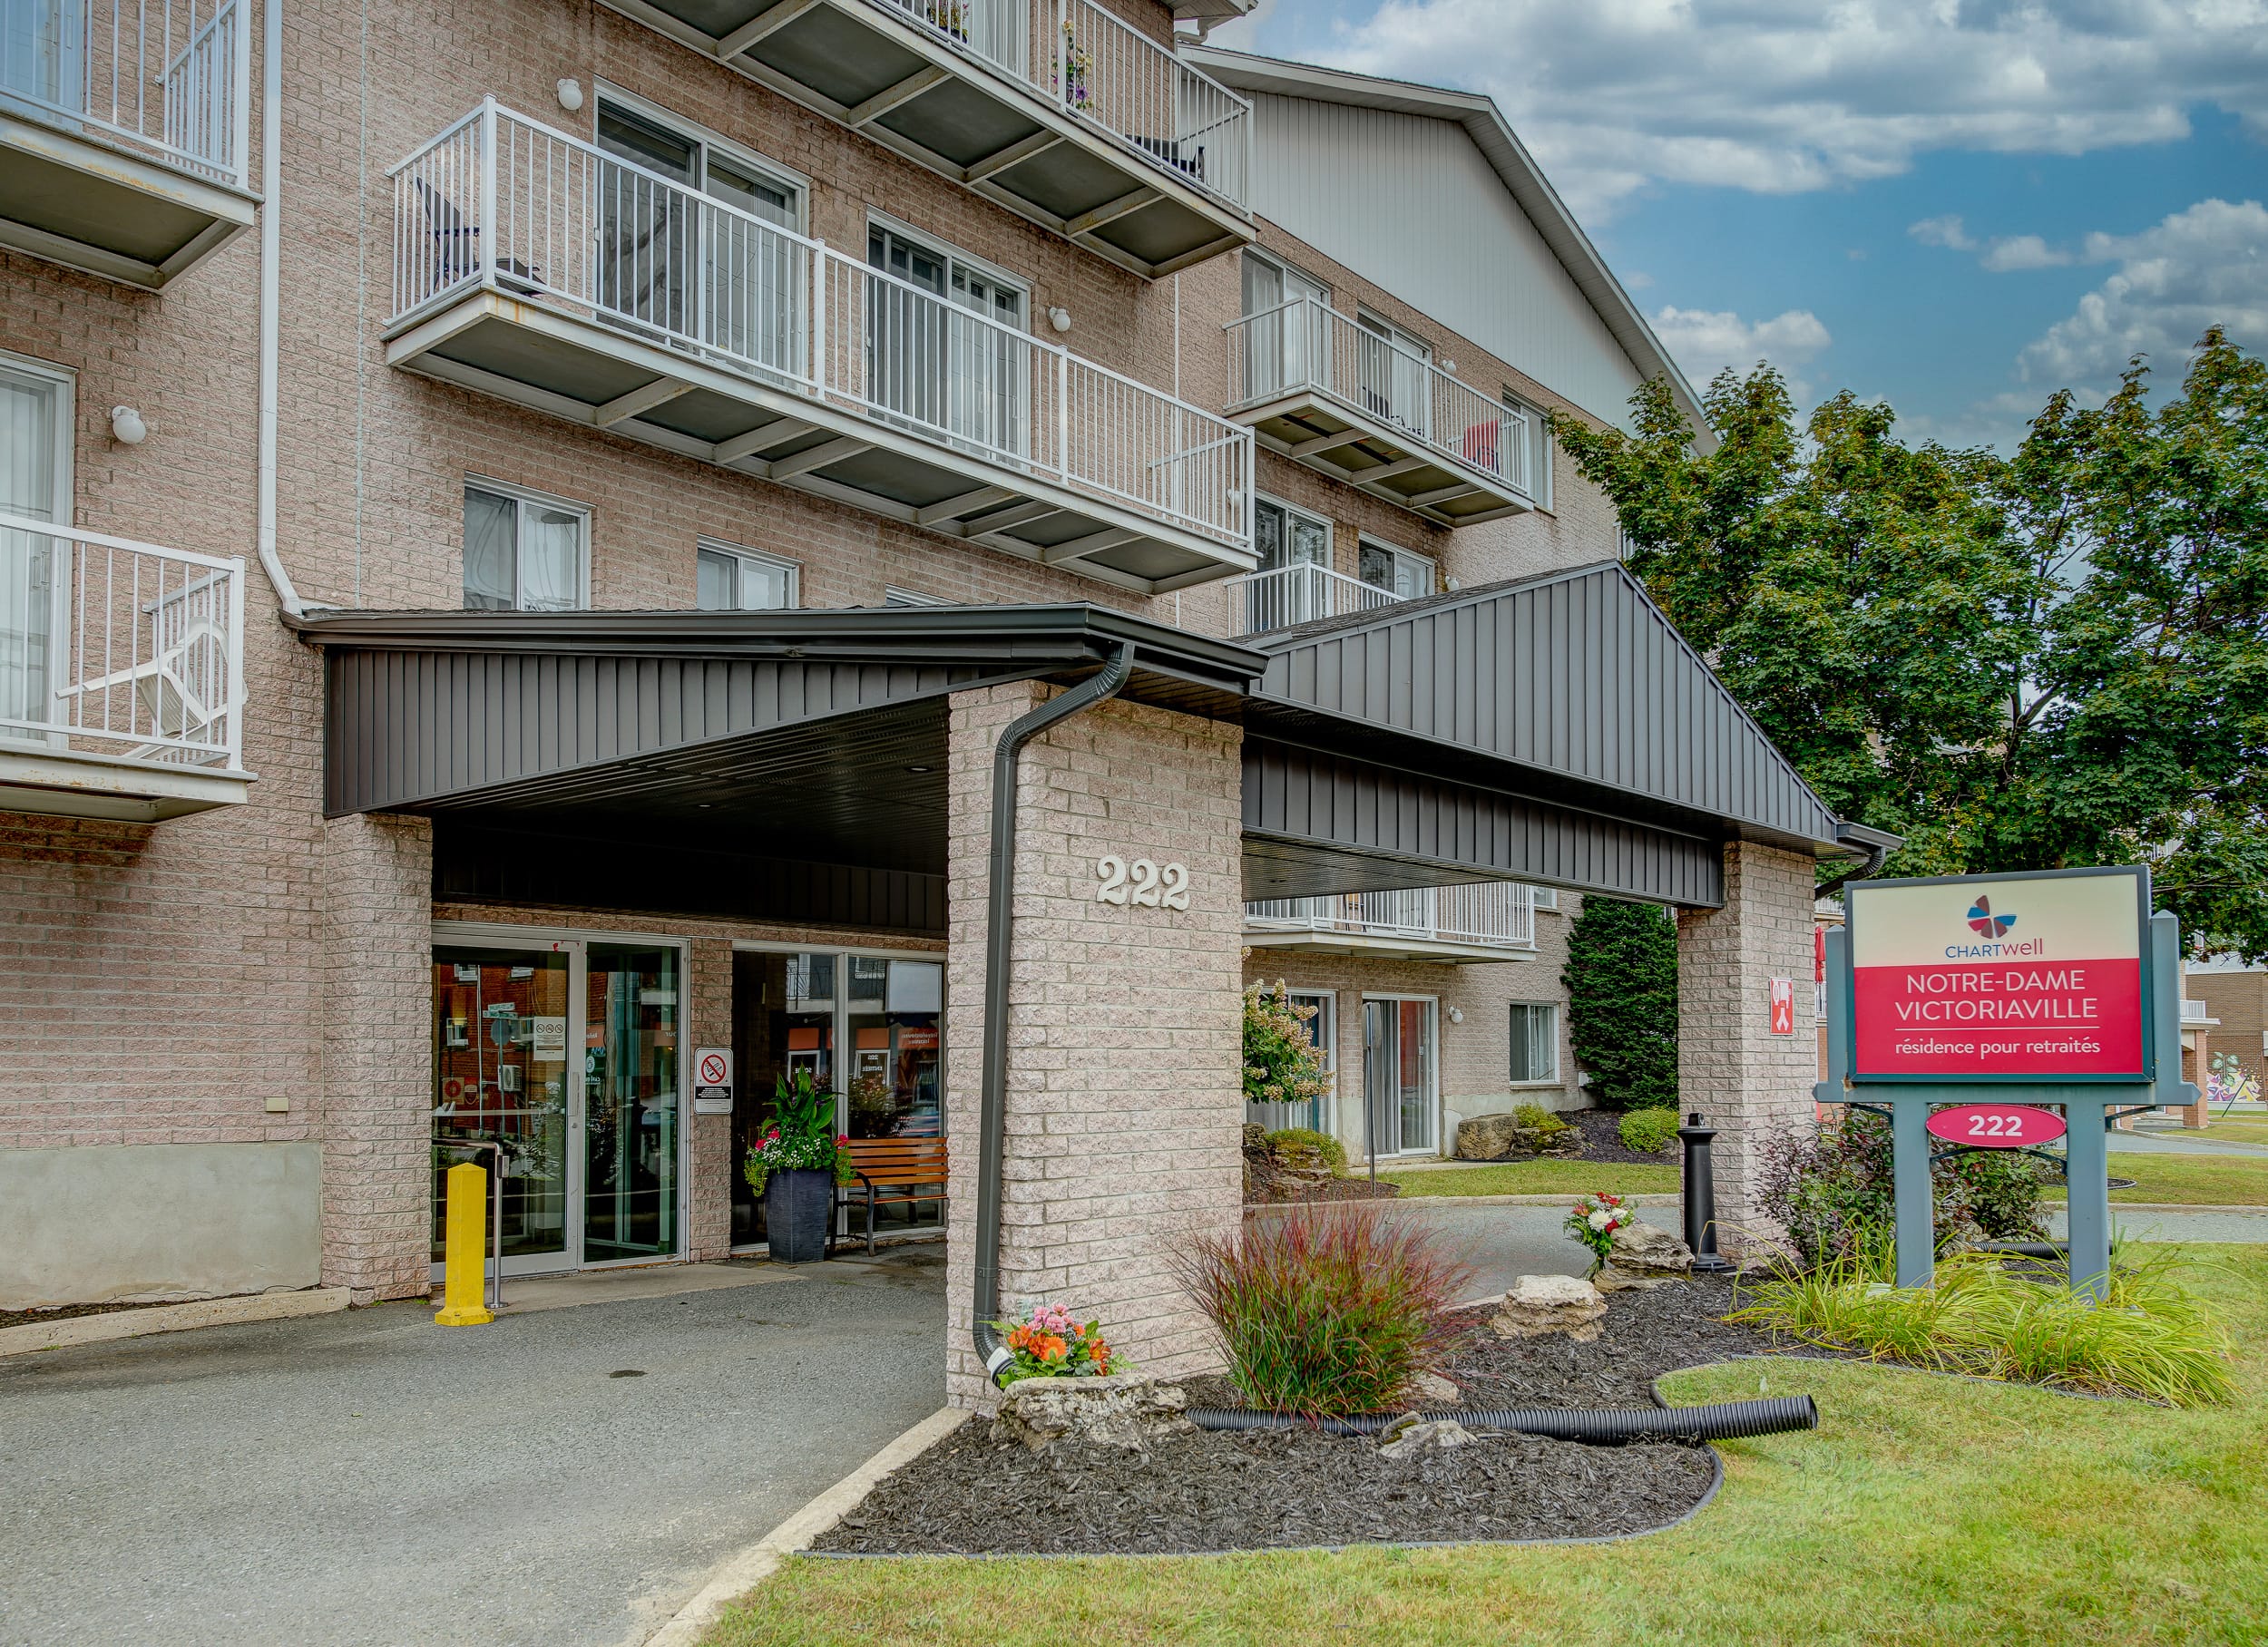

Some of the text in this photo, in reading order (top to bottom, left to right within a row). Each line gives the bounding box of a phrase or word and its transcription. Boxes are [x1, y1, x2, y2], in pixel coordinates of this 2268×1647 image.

[1096, 855, 1190, 911] 222
[1944, 938, 2043, 959] CHARTwell
[1907, 970, 2086, 994] NOTRE-DAME
[1894, 998, 2098, 1021] VICTORIAVILLE
[1895, 1036, 2100, 1059] résidence pour retraités
[1968, 1115, 2023, 1136] 222
